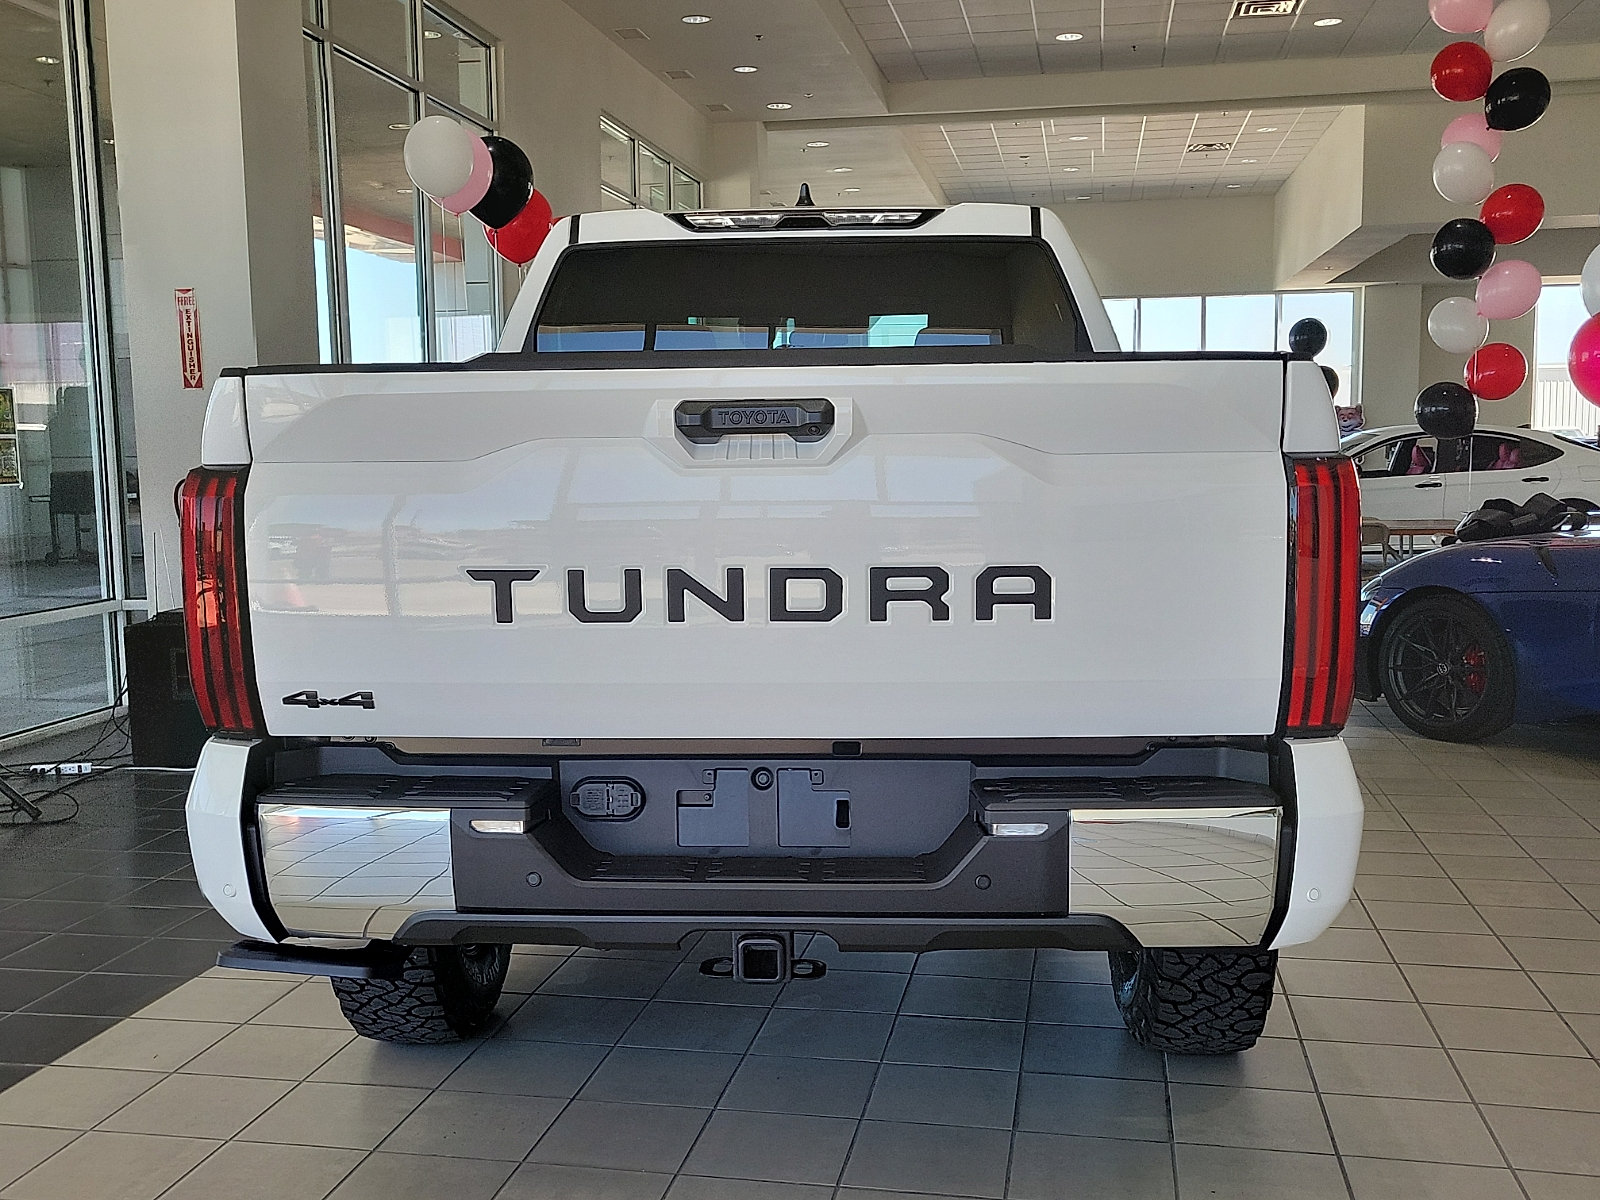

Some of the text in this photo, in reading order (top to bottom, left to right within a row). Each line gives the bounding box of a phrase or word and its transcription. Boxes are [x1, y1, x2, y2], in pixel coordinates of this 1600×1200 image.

[185, 308, 196, 381] EXTINGUISHER
[718, 409, 790, 425] TOYOTA
[465, 565, 1052, 623] TUNDRA
